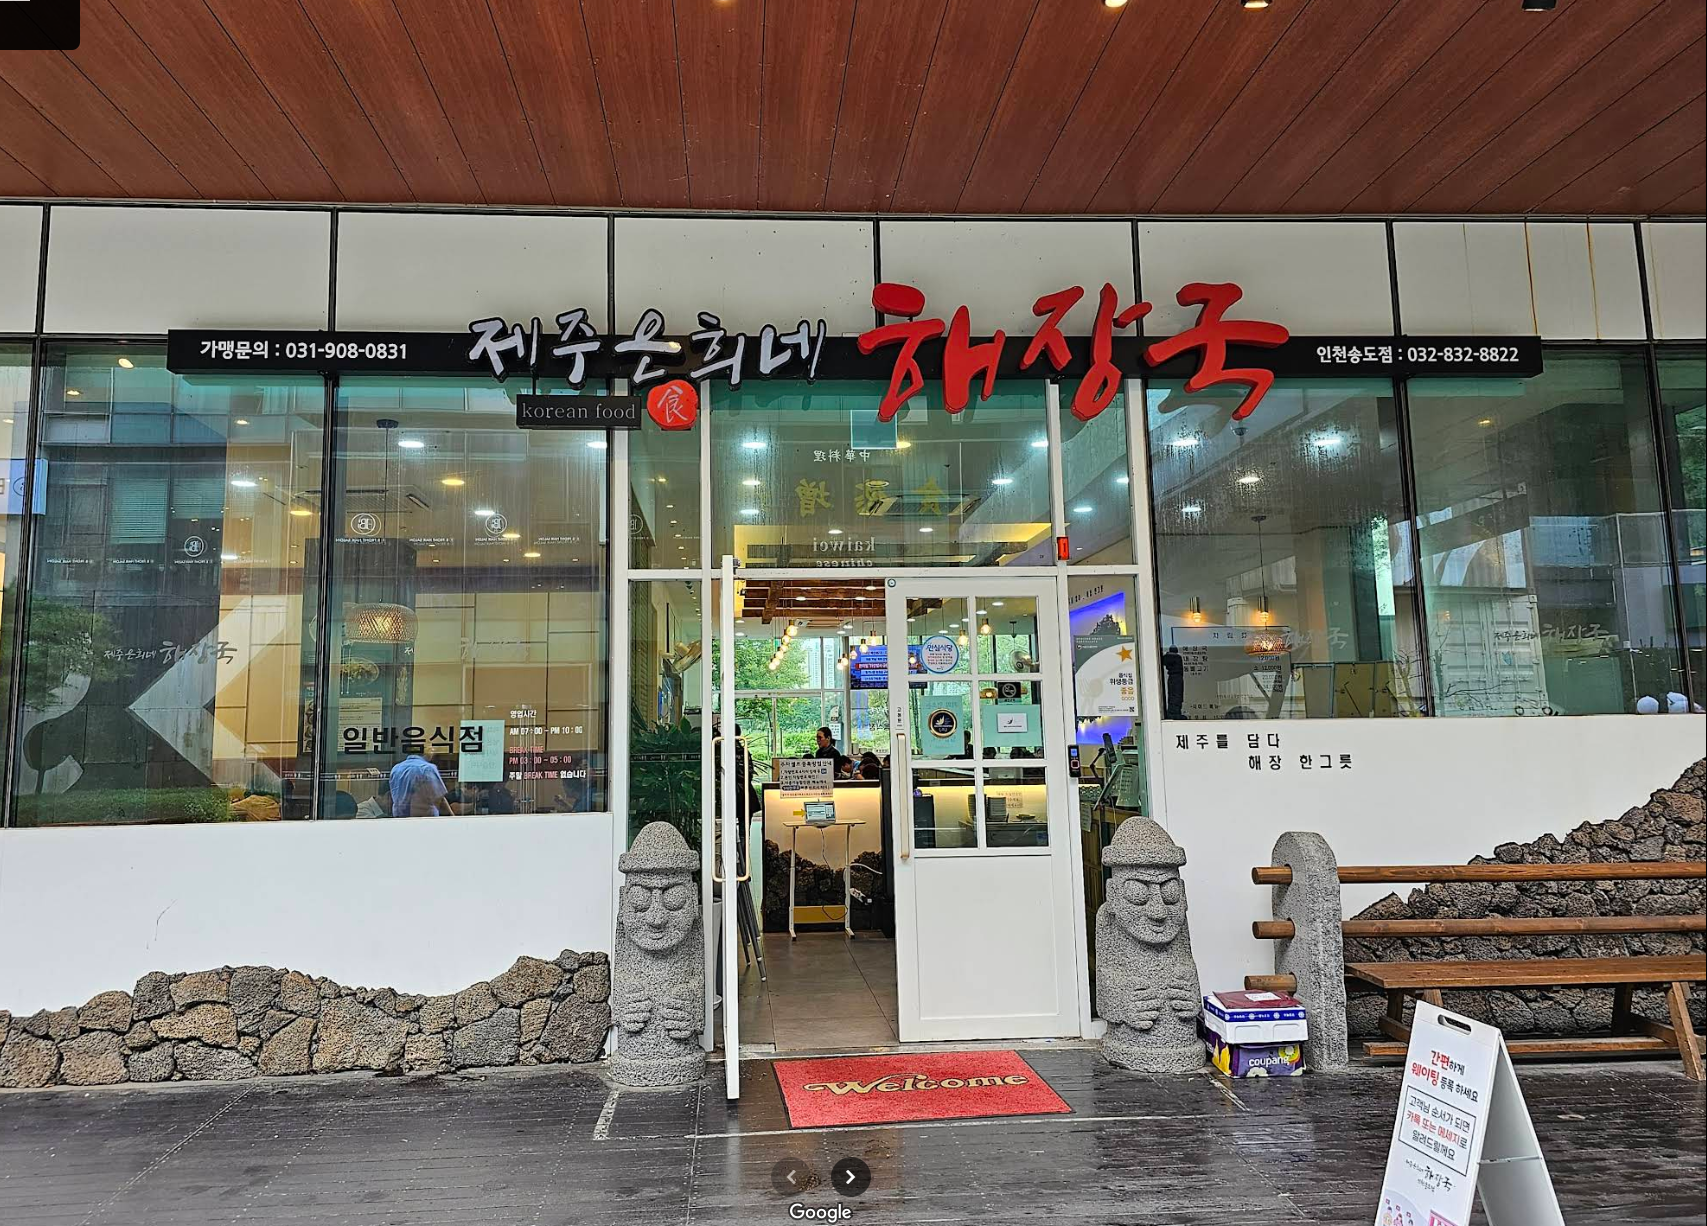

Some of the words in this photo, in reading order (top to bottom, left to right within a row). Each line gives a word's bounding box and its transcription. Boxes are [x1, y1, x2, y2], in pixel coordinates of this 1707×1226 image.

[200, 340, 268, 359] 가맹문의
[285, 342, 407, 360] 031-908-0831
[469, 308, 828, 389] 제주온희네
[857, 282, 1290, 422] 해장국
[1316, 346, 1393, 364] 인천송도점
[1407, 347, 1519, 362] 032-832-8822
[521, 403, 588, 419] korean
[596, 402, 636, 420] food
[657, 386, 688, 424] 食
[510, 710, 537, 719] 영업시간
[343, 725, 484, 755] 일반음식점
[1176, 734, 1229, 749] 제주를
[1247, 733, 1281, 749] 담다
[1249, 755, 1282, 770] 해장
[1299, 754, 1352, 769] 한그릇
[560, 771, 586, 779] 없습니다
[1249, 1056, 1289, 1067] coupang
[1431, 1050, 1465, 1076] 간편하게
[803, 1073, 1029, 1096] Welcome
[1411, 1062, 1440, 1087] 웨이팅
[1440, 1076, 1454, 1093] 등록
[1455, 1083, 1479, 1103] 하세요
[1406, 1109, 1421, 1126] 카톡
[1421, 1117, 1437, 1134] 또는
[1408, 1095, 1431, 1114] 고객님
[1431, 1106, 1454, 1125] 순서가
[1454, 1117, 1471, 1134] 되면
